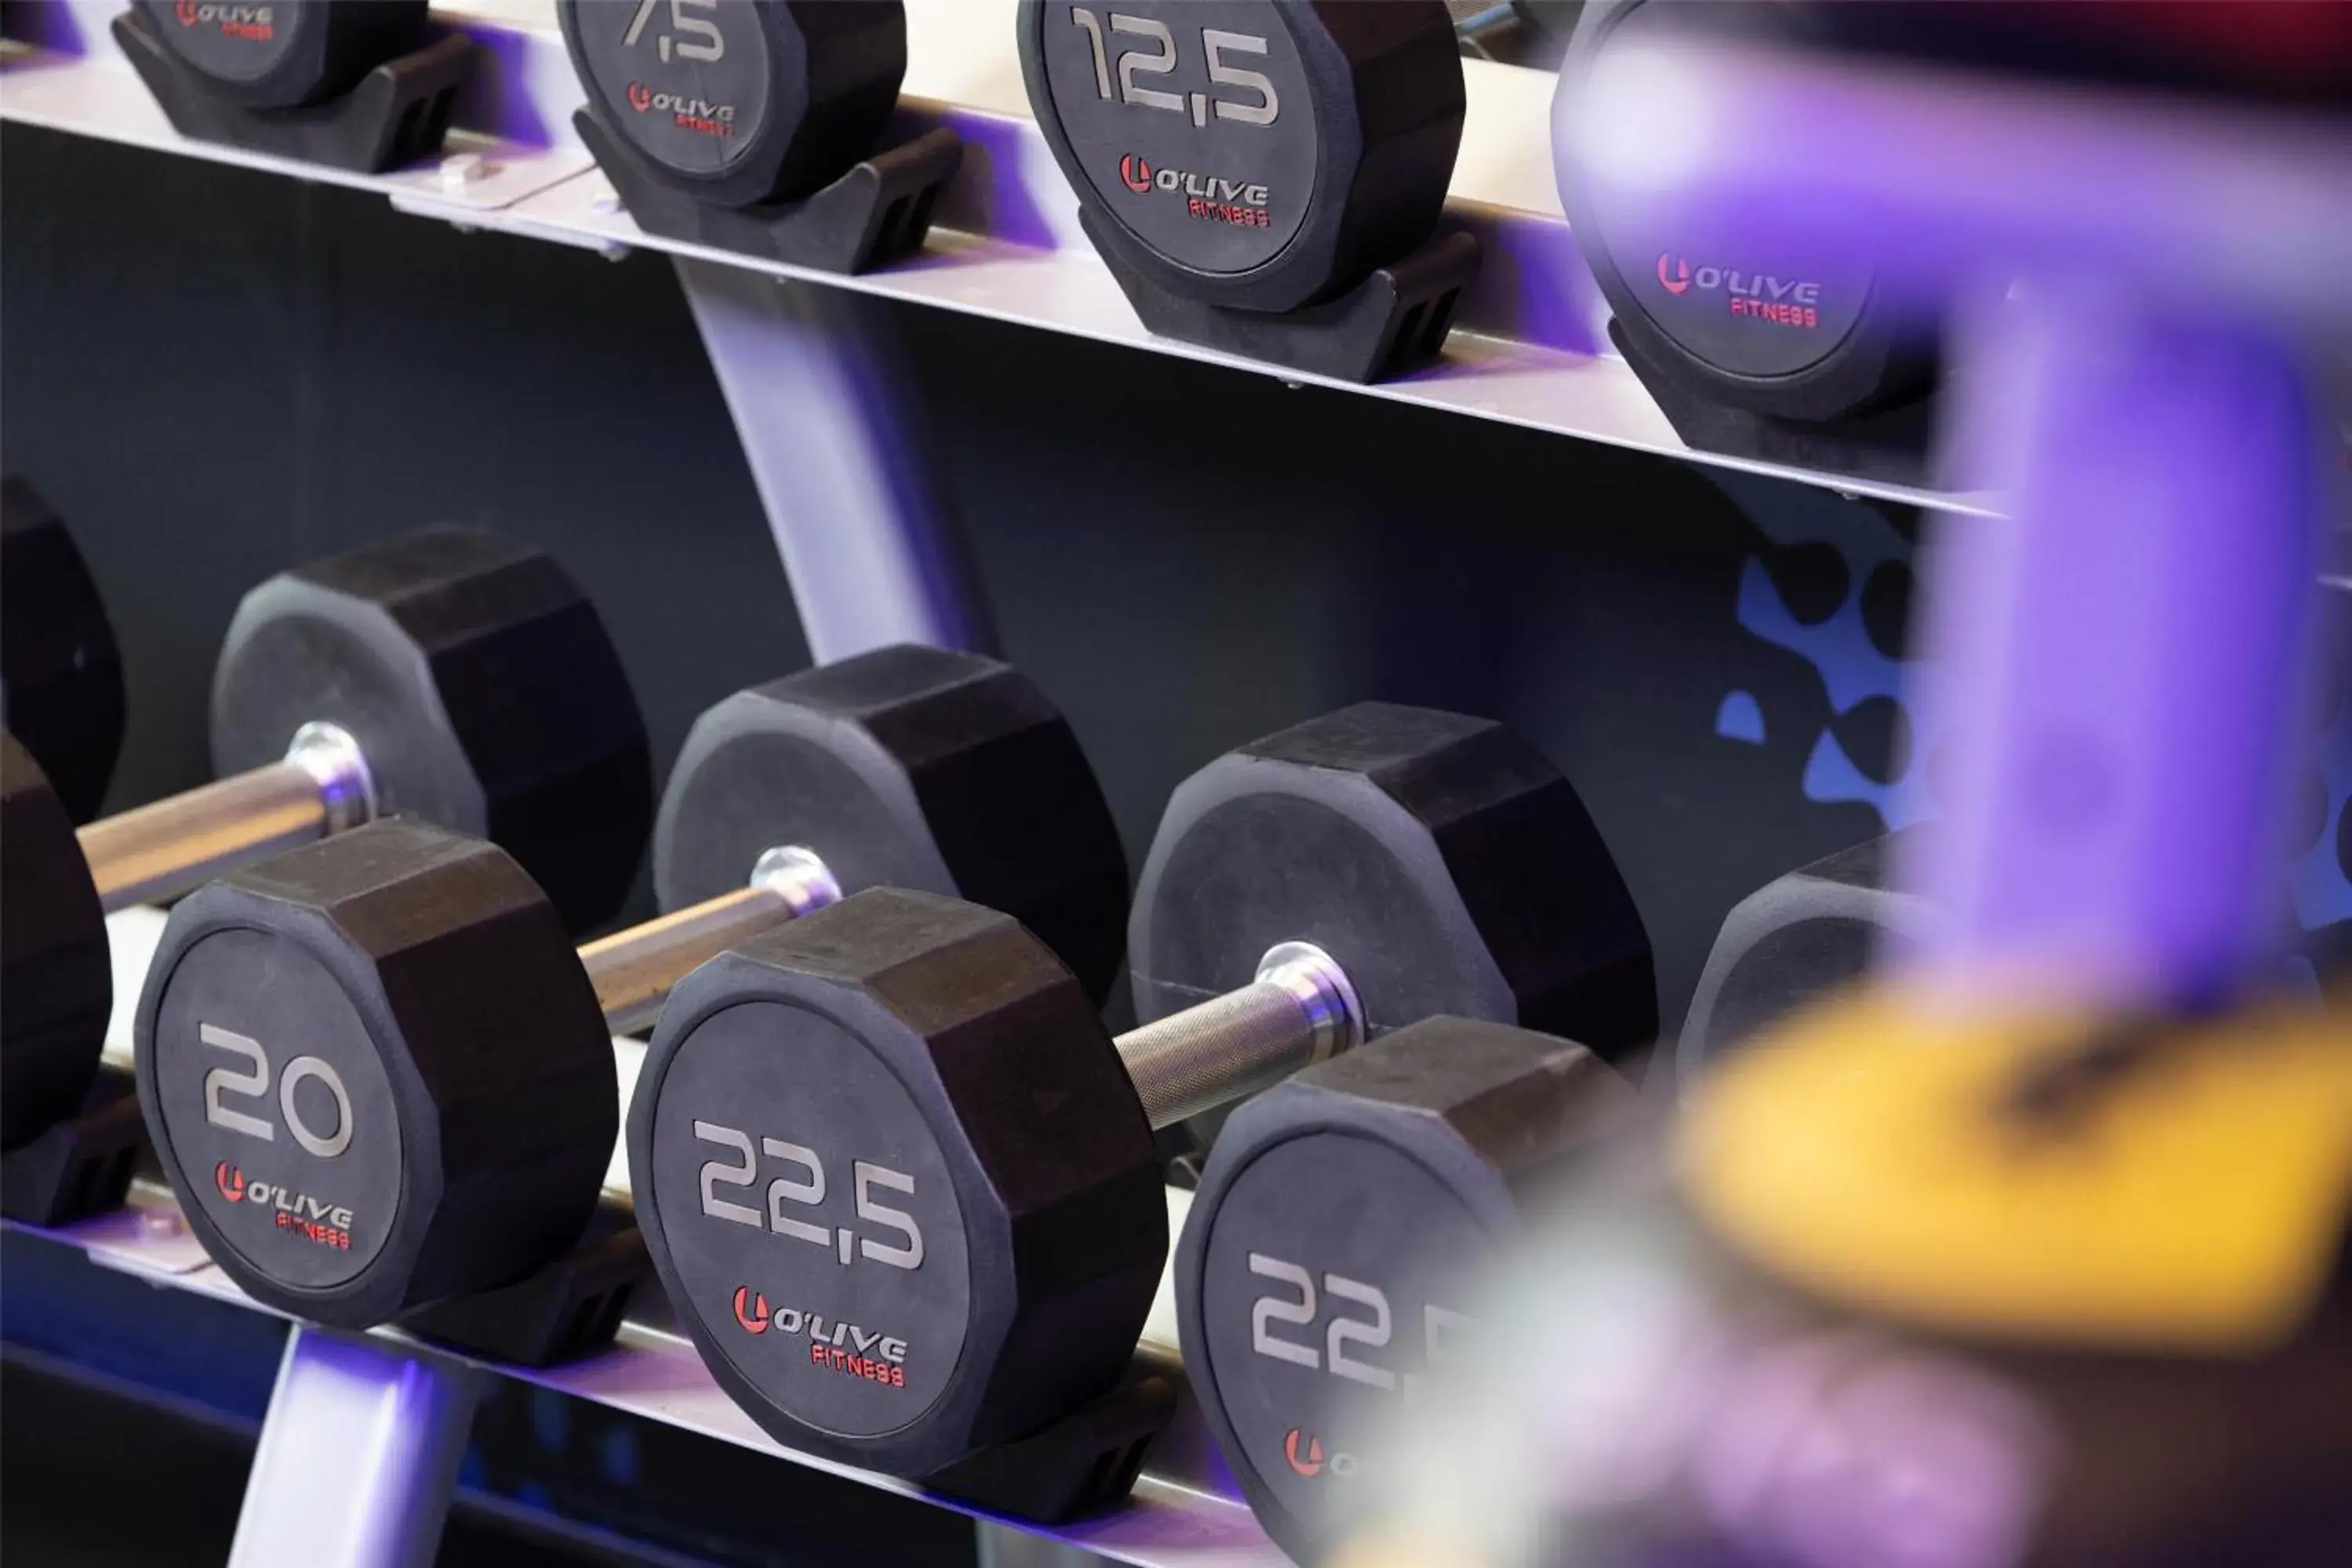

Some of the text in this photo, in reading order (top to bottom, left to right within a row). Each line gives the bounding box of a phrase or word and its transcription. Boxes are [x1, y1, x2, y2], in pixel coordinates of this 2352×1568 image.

[1070, 6, 1279, 128] 12,5
[1155, 169, 1269, 206] O'LIVE
[1188, 197, 1270, 227] FITNESS
[1695, 267, 1821, 304] O'LIVE
[1730, 298, 1818, 327] FITNESS
[199, 1022, 353, 1159] 20
[247, 1181, 353, 1230] O'LIVE
[693, 1119, 924, 1270] 22,5
[276, 1211, 351, 1252] FITNESS
[773, 1308, 907, 1363] O'LIVE
[811, 1344, 906, 1388] FITNESS
